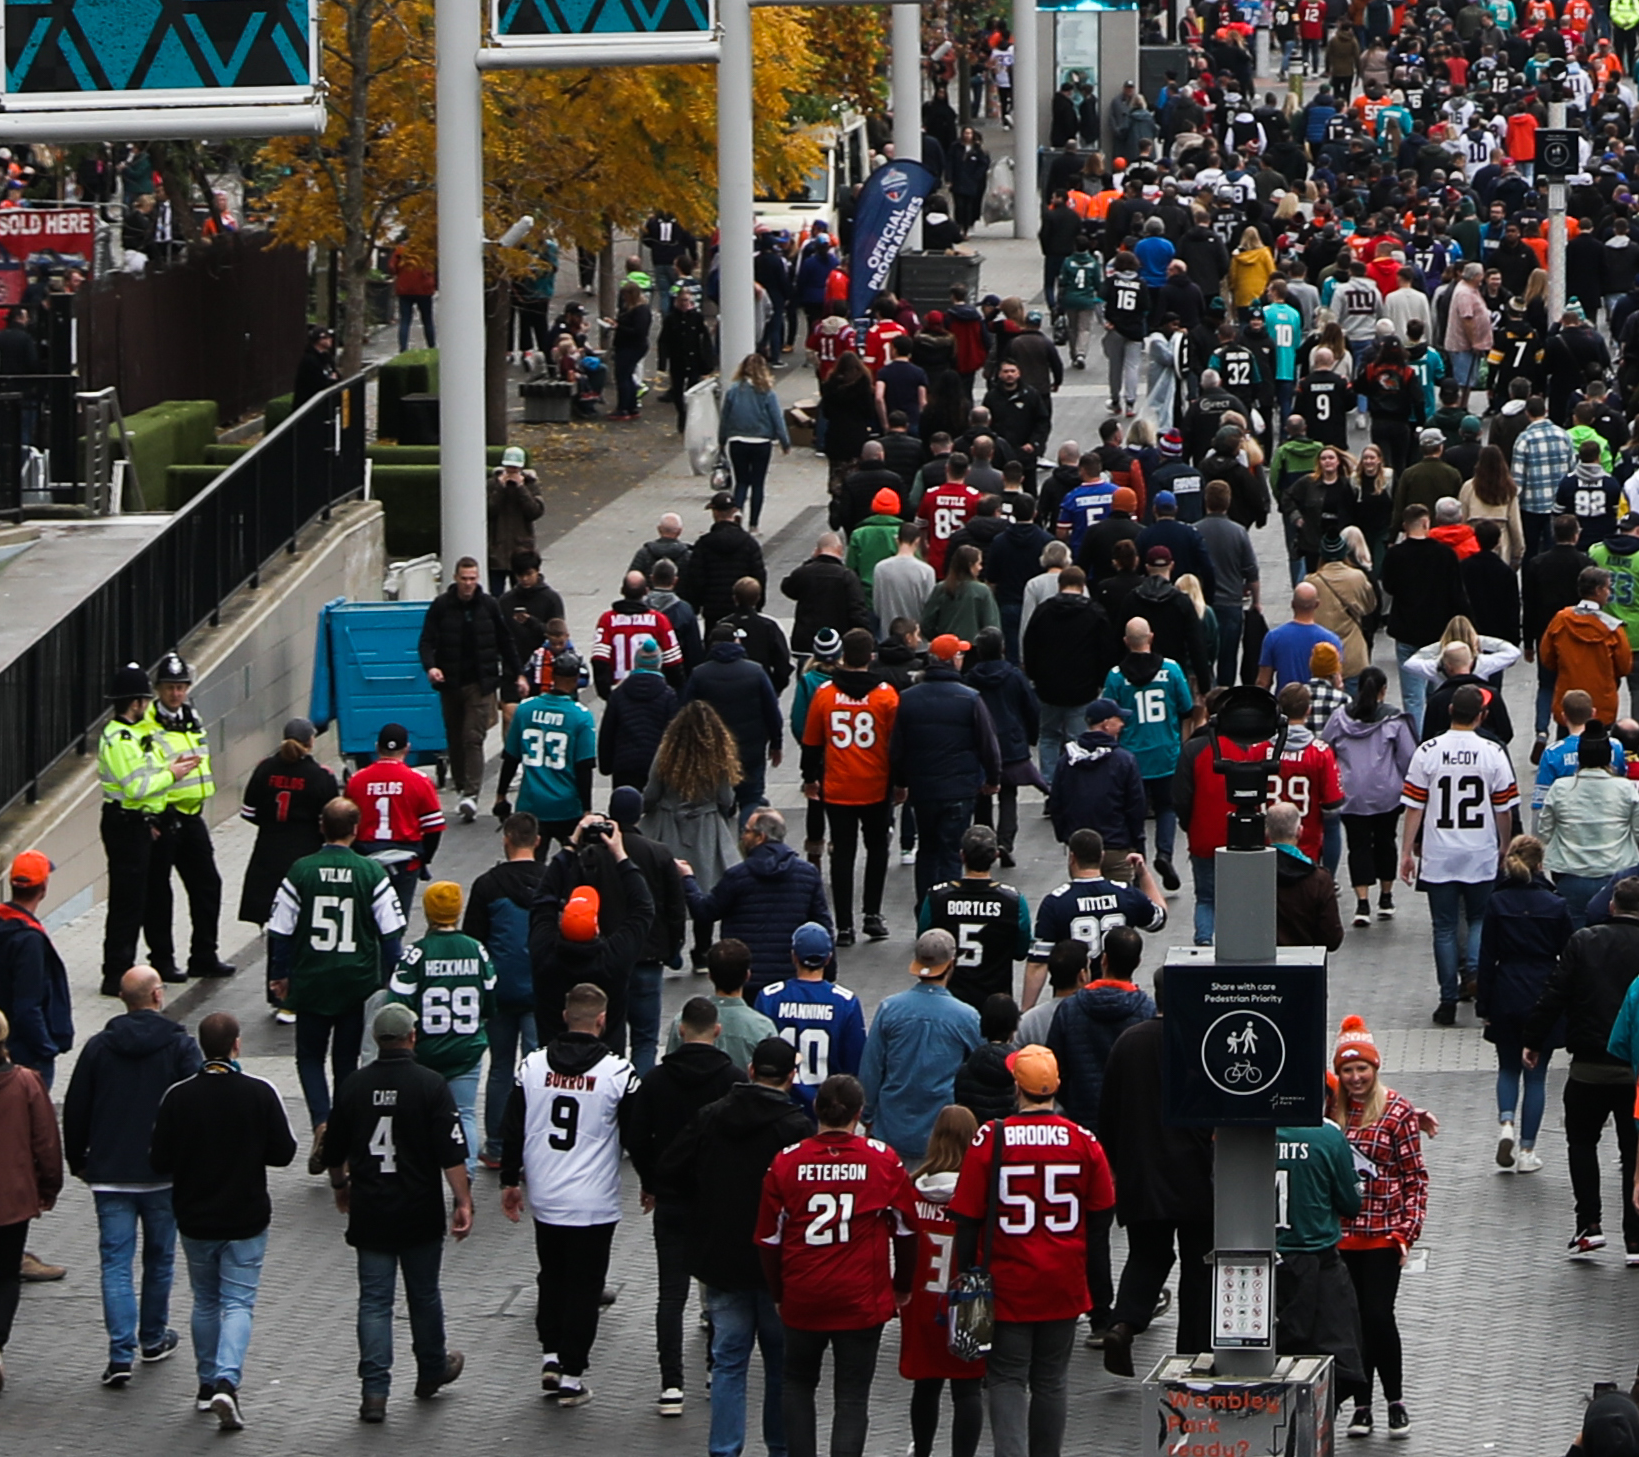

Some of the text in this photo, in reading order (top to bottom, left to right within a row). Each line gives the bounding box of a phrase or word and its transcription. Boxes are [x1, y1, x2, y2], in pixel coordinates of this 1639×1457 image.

[45, 211, 91, 235] HERE
[867, 206, 907, 270] OFFICIAL
[868, 195, 925, 291] PROGRAMMES
[1116, 289, 1137, 311] 16
[1275, 324, 1293, 347] 10
[1512, 341, 1527, 368] 7
[1227, 362, 1250, 385] 32
[1315, 393, 1331, 421] 9
[532, 710, 564, 724] LLOYD
[1133, 689, 1168, 724] 16
[830, 710, 877, 749] 58
[522, 728, 567, 770] 33
[1442, 749, 1480, 767] McCOY
[268, 774, 305, 791] FIELDS
[366, 781, 403, 797] FIELDS
[275, 791, 292, 821] 1
[1435, 775, 1485, 830] 12
[374, 797, 393, 841] 1
[318, 867, 354, 884] VILMA
[946, 900, 1002, 917] BORTLES
[1076, 894, 1118, 912] WITTEN
[310, 895, 357, 954] 51
[956, 923, 984, 968] 5
[424, 957, 480, 978] HECKMAN
[1211, 981, 1277, 992] Share with care
[421, 986, 481, 1035] 69
[1204, 993, 1283, 1005] Pedestrian Priority
[778, 1001, 834, 1022] MANNING
[544, 1071, 597, 1092] BURROW
[372, 1089, 398, 1106] CARR
[547, 1094, 579, 1152] 9
[368, 1115, 398, 1174] 4
[1004, 1125, 1070, 1146] BROOKS
[797, 1163, 868, 1182] PETERSON
[998, 1164, 1082, 1235] 55
[804, 1193, 855, 1247] 21
[1166, 1390, 1281, 1413] Wembley
[1166, 1414, 1220, 1435] Park
[1166, 1438, 1251, 1457] ready?
